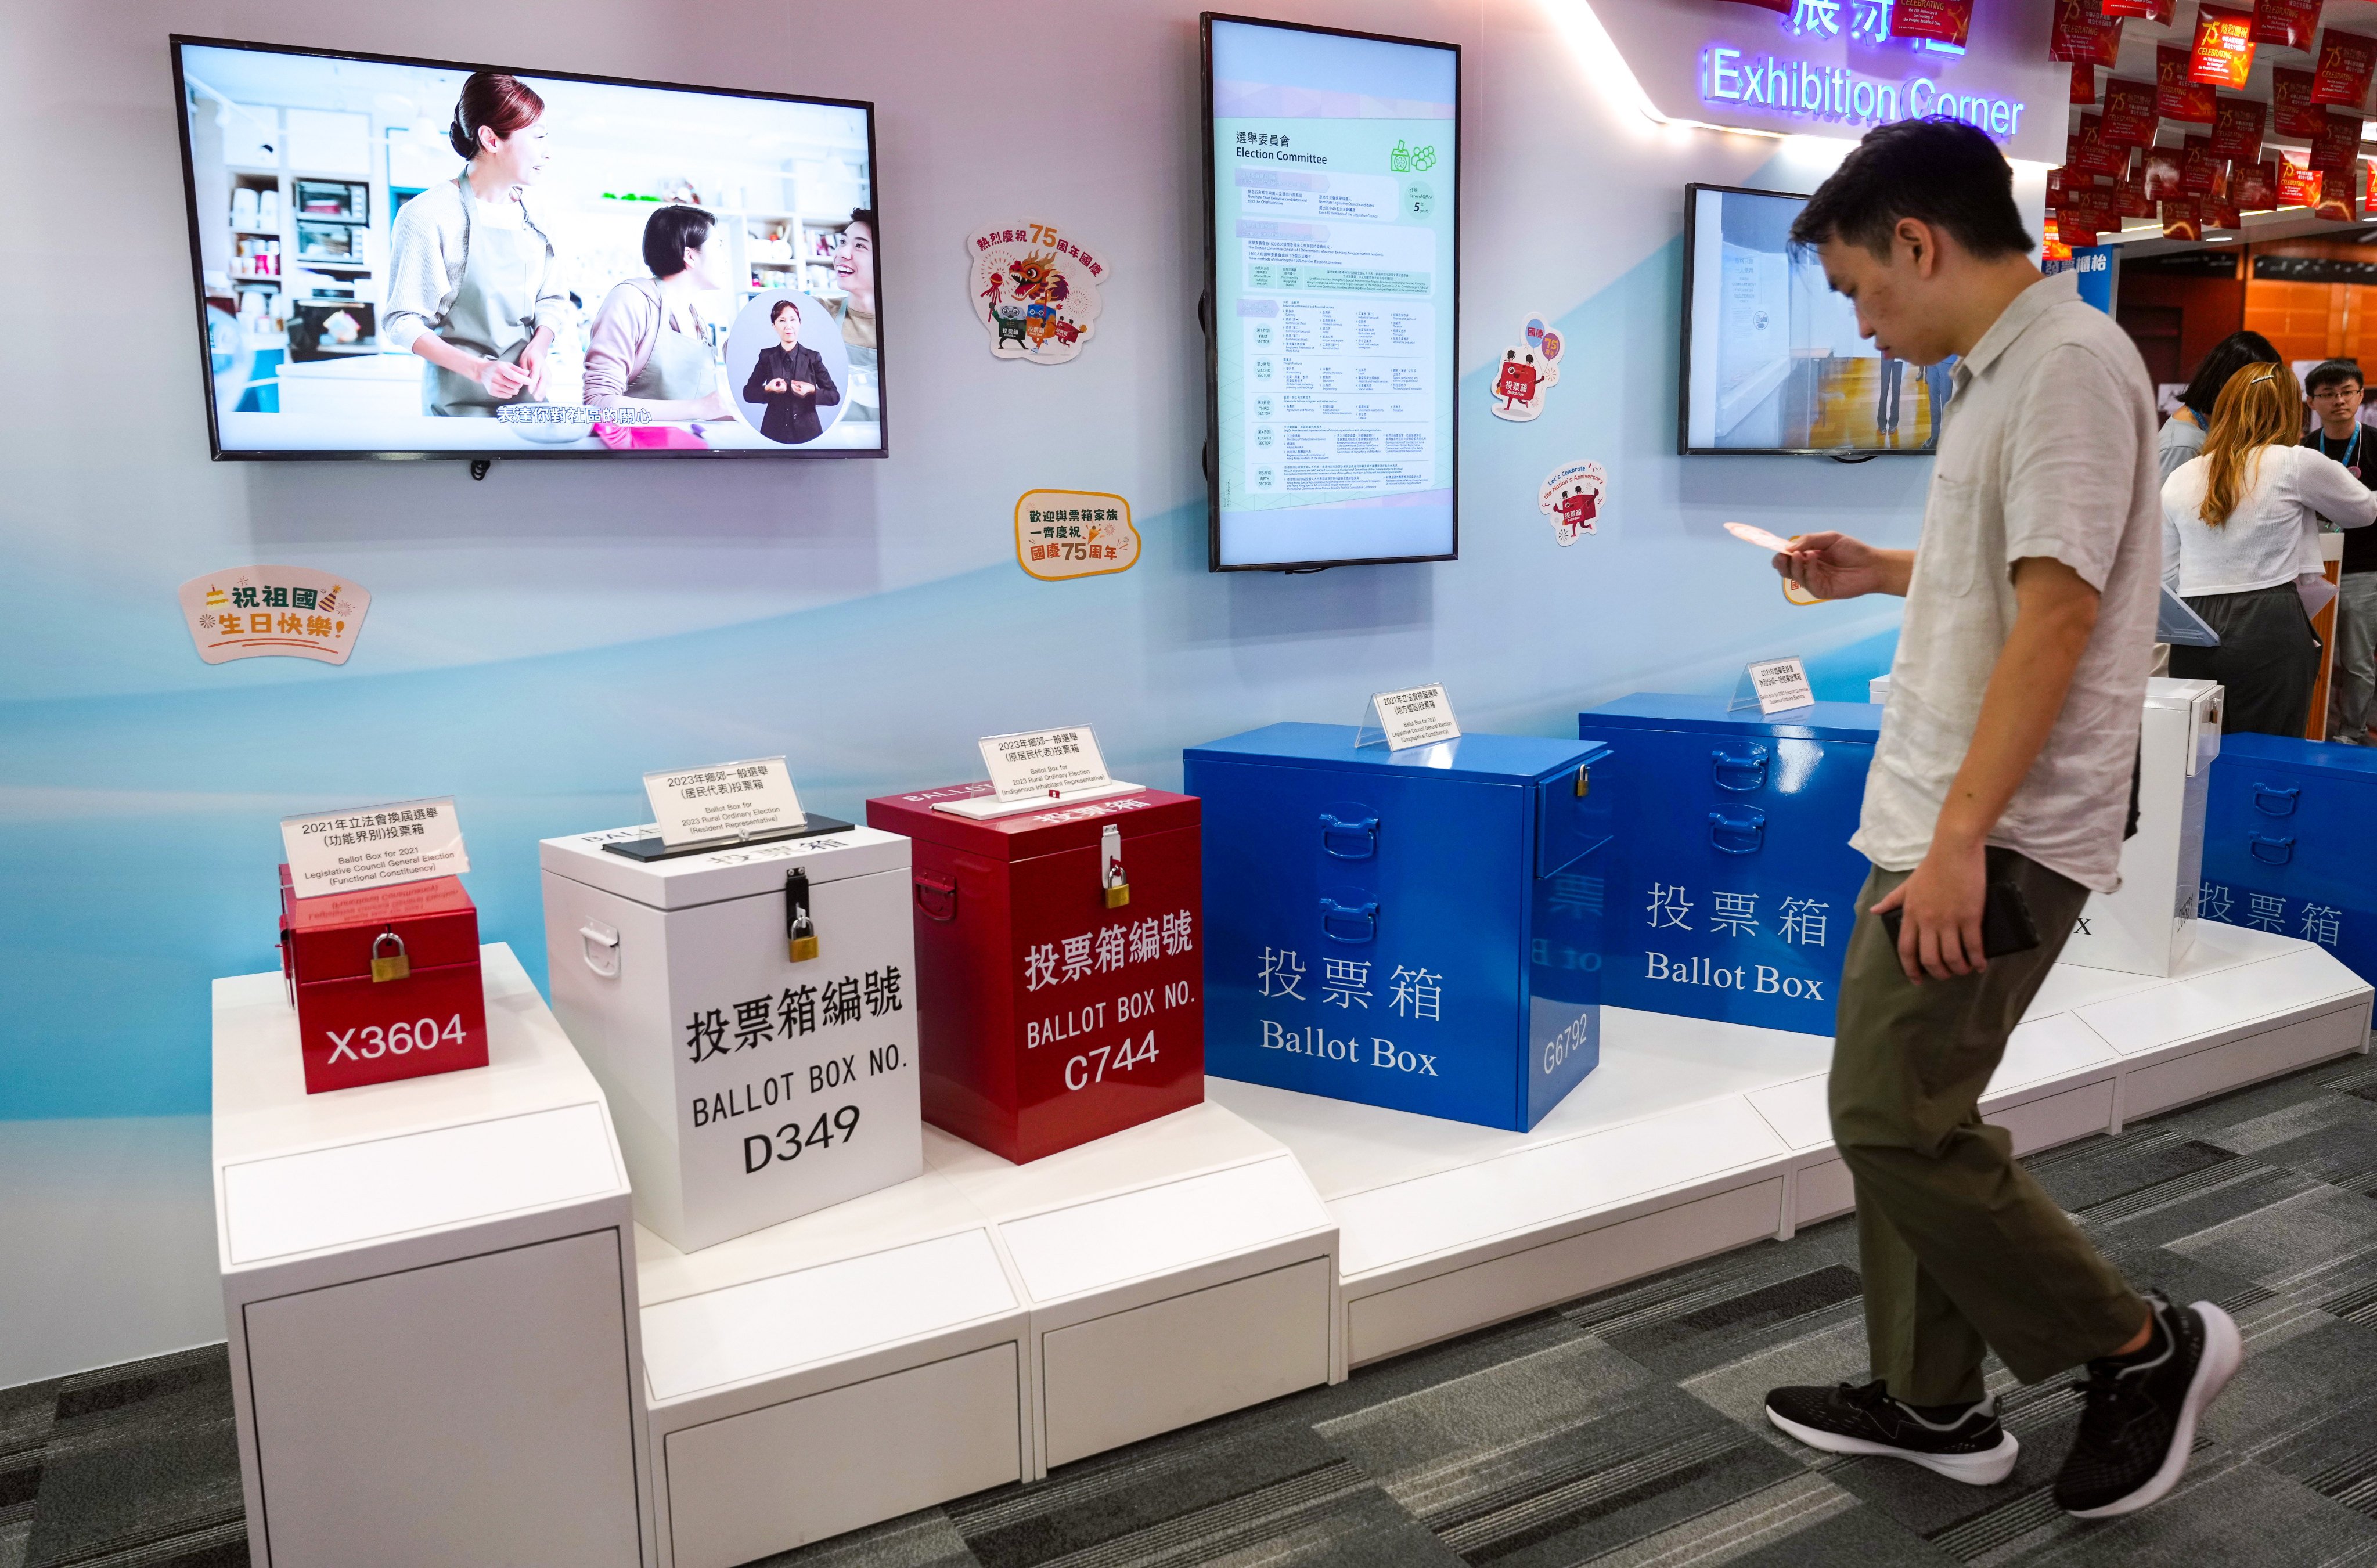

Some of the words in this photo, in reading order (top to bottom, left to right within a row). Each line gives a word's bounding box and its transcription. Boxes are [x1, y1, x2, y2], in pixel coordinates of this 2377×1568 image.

[1901, 0, 1944, 10] CELEBRATING
[2060, 24, 2098, 35] CELEBRATING
[2201, 21, 2220, 46] 75
[2198, 48, 2232, 59] CELEBRATING
[2322, 70, 2353, 81] CELEBRATING
[1713, 48, 1895, 120] Exhibition
[1910, 78, 2024, 135] Corner
[1236, 131, 1290, 147] 選舉委員會
[1236, 147, 1274, 160] Election
[1276, 150, 1327, 164] Committee
[1414, 202, 1420, 211] 5
[1528, 327, 1544, 339] 國慶
[1545, 338, 1558, 350] 75
[1506, 380, 1527, 393] 投票箱
[497, 406, 652, 424] 表達你對社區的關心
[1562, 467, 1585, 476] Celebrate
[1552, 478, 1572, 492] Nation's
[1574, 474, 1604, 484] Anniversary
[1029, 509, 1118, 522] 歡迎與票箱家族
[1565, 509, 1582, 519] 投票箱
[1030, 526, 1081, 538] 一齊慶祝
[1031, 542, 1117, 561] 國慶75周年
[232, 585, 318, 610] 祝祖國
[219, 612, 345, 638] 生日快樂!
[1383, 689, 1438, 705] 2021年立法會換屆選舉
[1394, 700, 1436, 715] (地方選區)投票箱
[998, 732, 1078, 751] 2023年鄉郊一般選舉
[1392, 729, 1411, 738] Legislative
[1400, 733, 1425, 744] (Geographical
[1426, 728, 1449, 738] Constituency)
[1005, 745, 1080, 763] (原居民代表)投票箱
[668, 765, 768, 787] 2023年鄉郊一般選舉
[1012, 777, 1026, 785] 2023
[1044, 772, 1067, 782] Ordinary
[1069, 769, 1090, 777] Election
[1031, 766, 1047, 774] Ballot
[681, 779, 764, 799] (居民代表)投票箱
[1002, 786, 1034, 797] (Indigenous
[1035, 782, 1062, 792] Inhabitant
[1064, 774, 1105, 788] Representative)
[682, 818, 700, 826] 2023
[702, 815, 721, 823] Rural
[723, 811, 751, 821] Ordinary
[753, 807, 780, 816] Election
[705, 805, 726, 813] Ballot
[727, 803, 741, 812] Box
[1033, 798, 1151, 824] 投票箱
[302, 807, 438, 834] 2021年立法會換屆選舉
[690, 823, 724, 835] (Resident
[725, 815, 778, 831] Representative)
[324, 824, 424, 848] (功能界別)投票箱
[338, 855, 362, 864] Ballot
[366, 852, 382, 861] Box
[399, 847, 419, 856] 2021
[706, 839, 849, 864] 投票箱
[305, 867, 351, 879] Legislative
[354, 862, 386, 872] Council
[388, 857, 420, 867] General
[423, 853, 455, 862] Election
[330, 874, 377, 886] (Functional
[380, 864, 436, 879] Constituency)
[1646, 882, 1829, 947] 投票箱
[2198, 882, 2342, 946] 投票箱
[1024, 909, 1193, 991] 投票箱編號
[1258, 947, 1442, 1021] 投票箱
[1645, 951, 1745, 990] Ballot
[1753, 965, 1824, 1001] Box
[686, 965, 903, 1064] 投票箱編號
[1027, 1003, 1106, 1049] BALLOT
[1118, 989, 1154, 1022] BOX
[1165, 981, 1195, 1008] NO.
[326, 1014, 466, 1064] X3604
[1260, 1019, 1359, 1063] Ballot
[1371, 1038, 1439, 1076] Box
[1544, 1013, 1587, 1075] G6792
[1065, 1030, 1159, 1090] C744
[693, 1072, 794, 1127] BALLOT
[810, 1055, 857, 1093] BOX
[870, 1044, 907, 1076] NO.
[744, 1105, 860, 1174] D349
